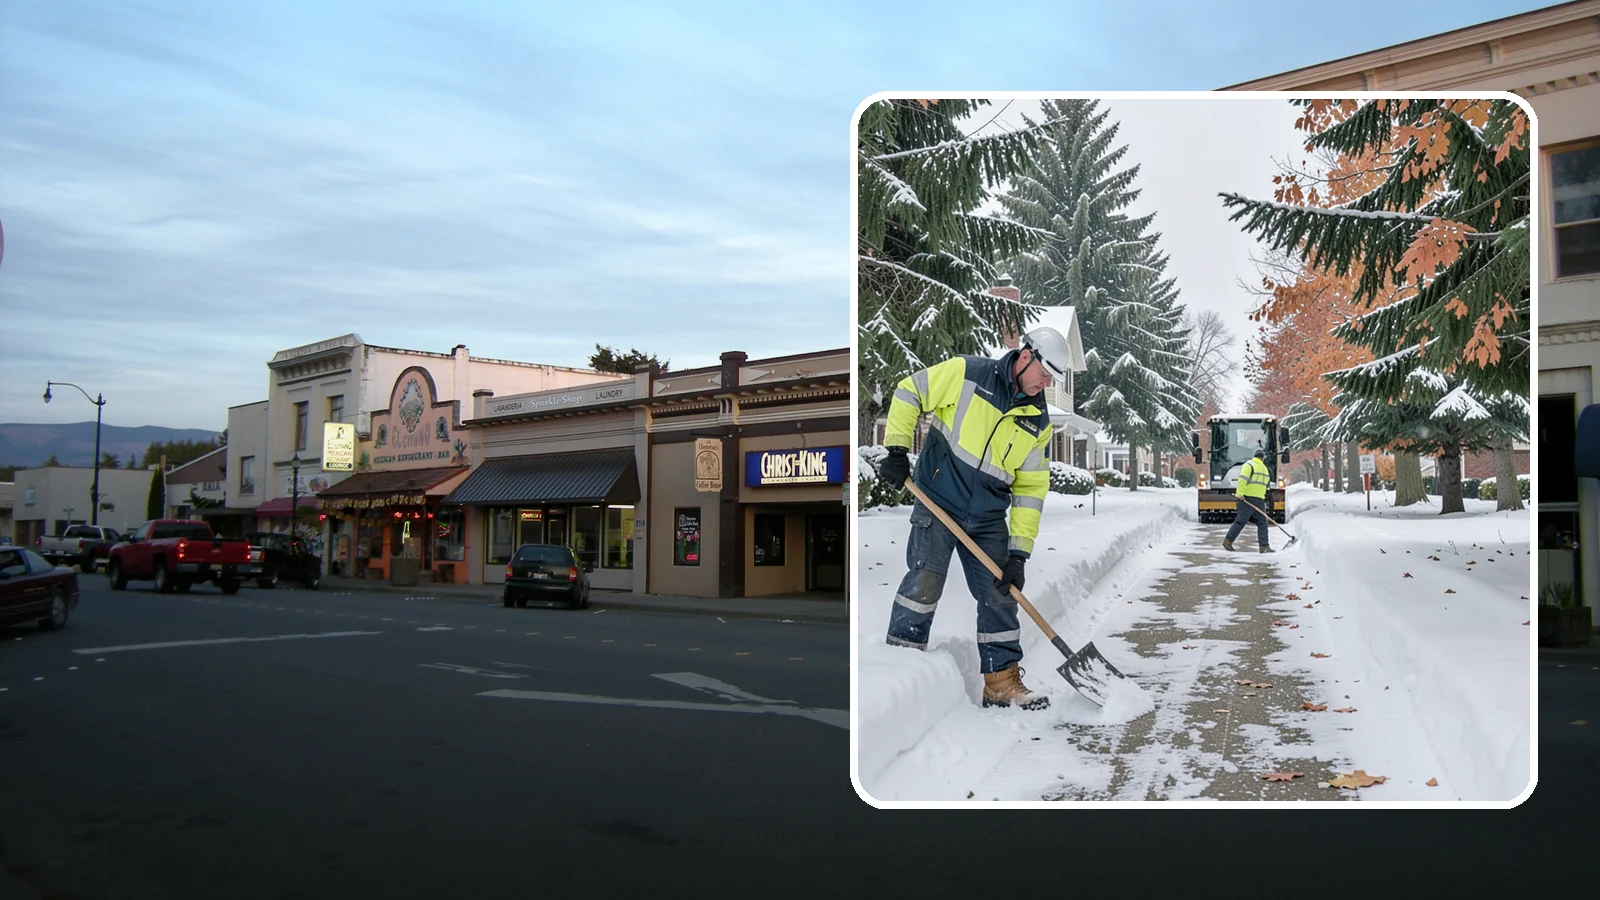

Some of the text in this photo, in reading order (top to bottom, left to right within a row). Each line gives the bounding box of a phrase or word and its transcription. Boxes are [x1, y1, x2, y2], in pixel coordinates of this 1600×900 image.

[595, 389, 624, 400] LAUNDRY
[493, 402, 522, 413] LAVANDERIA
[530, 394, 582, 409] Sparkle Shop
[373, 455, 396, 464] MEXICAN
[398, 451, 433, 462] RESTAURANT
[437, 450, 450, 459] BAR
